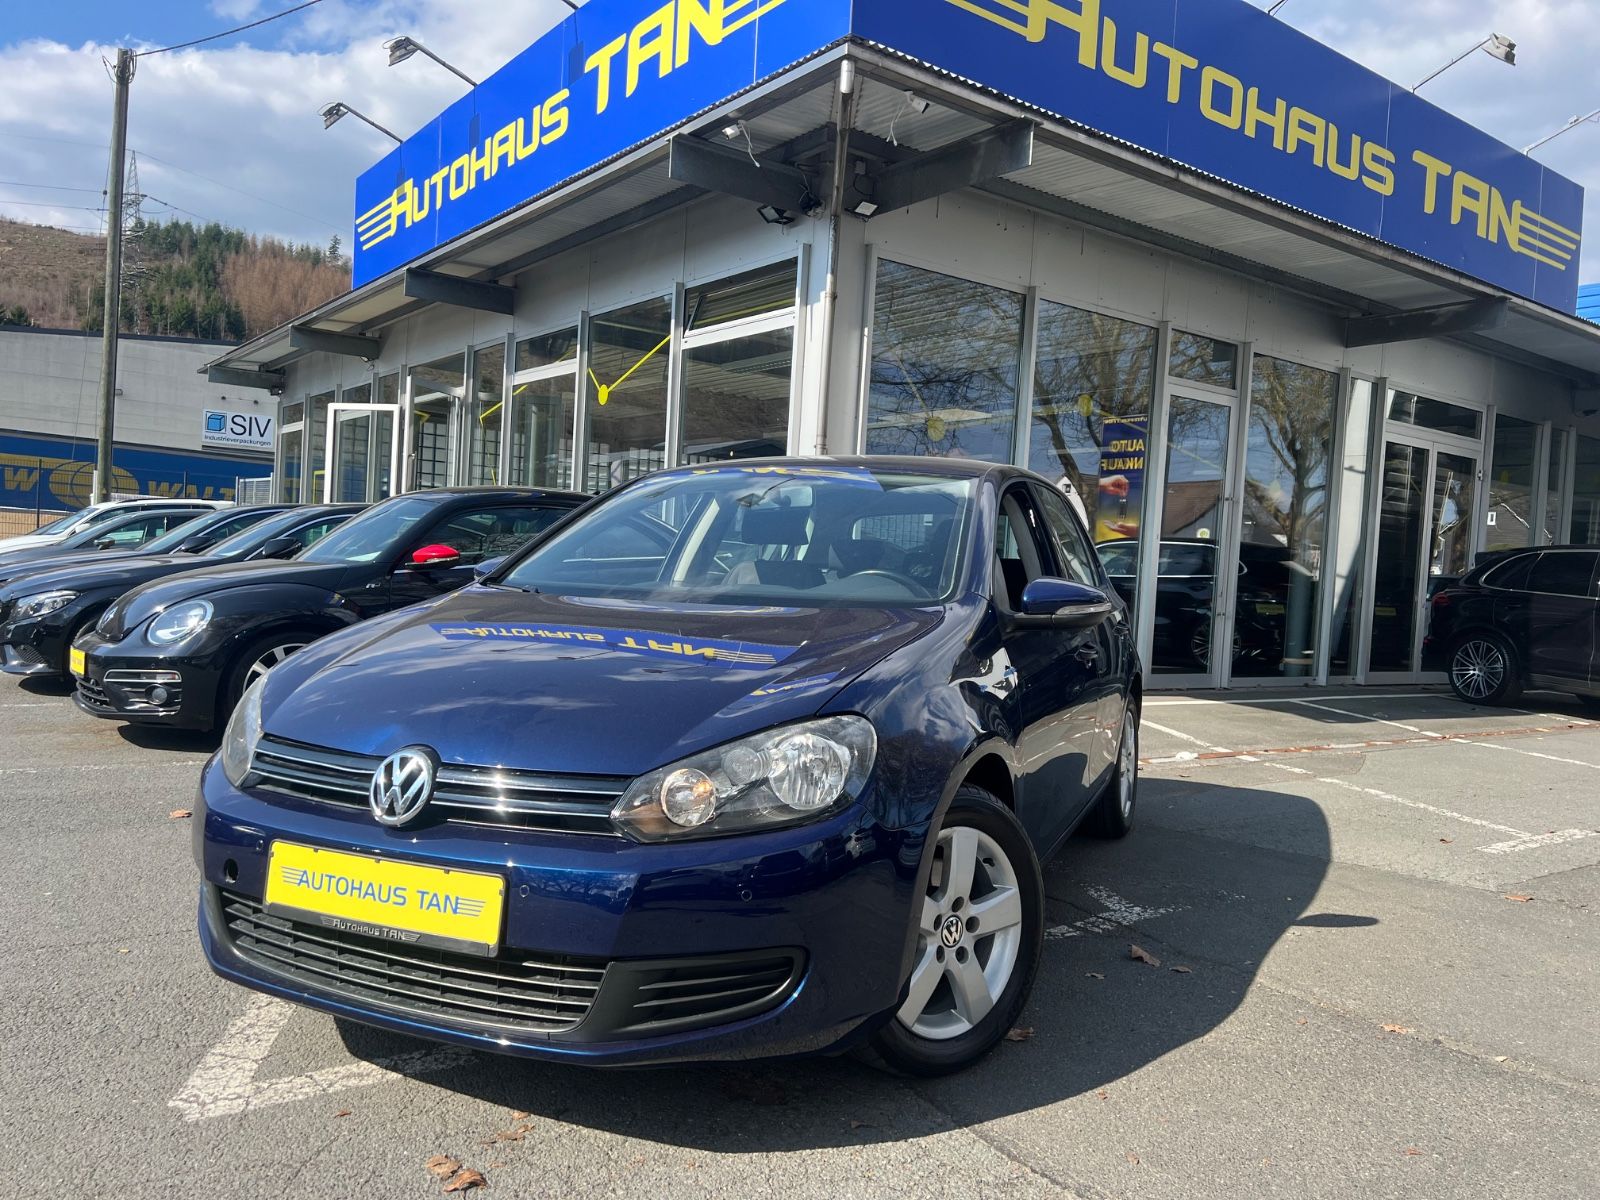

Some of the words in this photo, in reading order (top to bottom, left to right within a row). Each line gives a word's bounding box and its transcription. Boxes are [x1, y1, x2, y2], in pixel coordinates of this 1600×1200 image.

[391, 88, 570, 237] AUTOHAUS
[584, 0, 724, 114] TAN
[1026, 0, 1397, 196] AUTOHAUS
[1411, 150, 1521, 253] TAN
[204, 434, 272, 447] Industrieverpackungen
[230, 414, 272, 438] SIV
[298, 869, 407, 907] AUTOHAUS
[416, 890, 460, 916] TAN
[332, 918, 380, 936] AUTOHAUS
[382, 928, 405, 940] TAN
